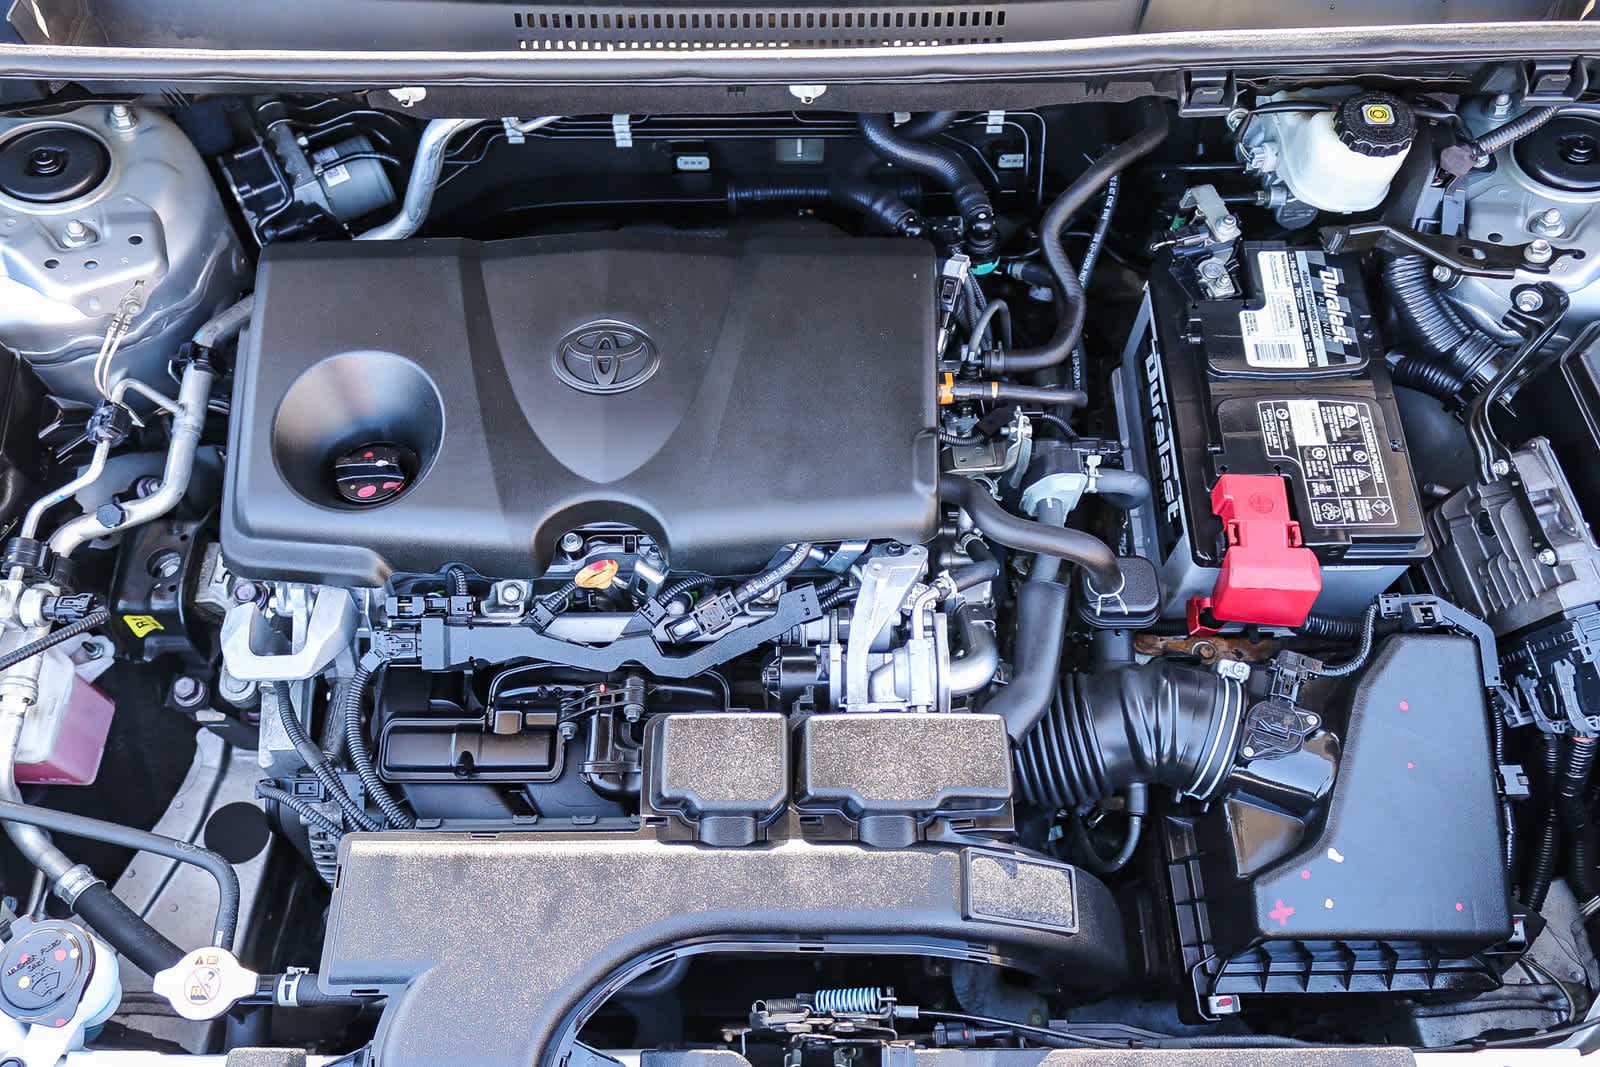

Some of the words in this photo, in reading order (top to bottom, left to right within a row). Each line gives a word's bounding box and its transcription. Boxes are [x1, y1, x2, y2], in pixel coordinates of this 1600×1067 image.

[1305, 289, 1321, 339] TECHNOLOGY
[1316, 295, 1332, 341] PLATINUM
[1319, 268, 1353, 345] Duralast
[1145, 342, 1180, 523] Duralast
